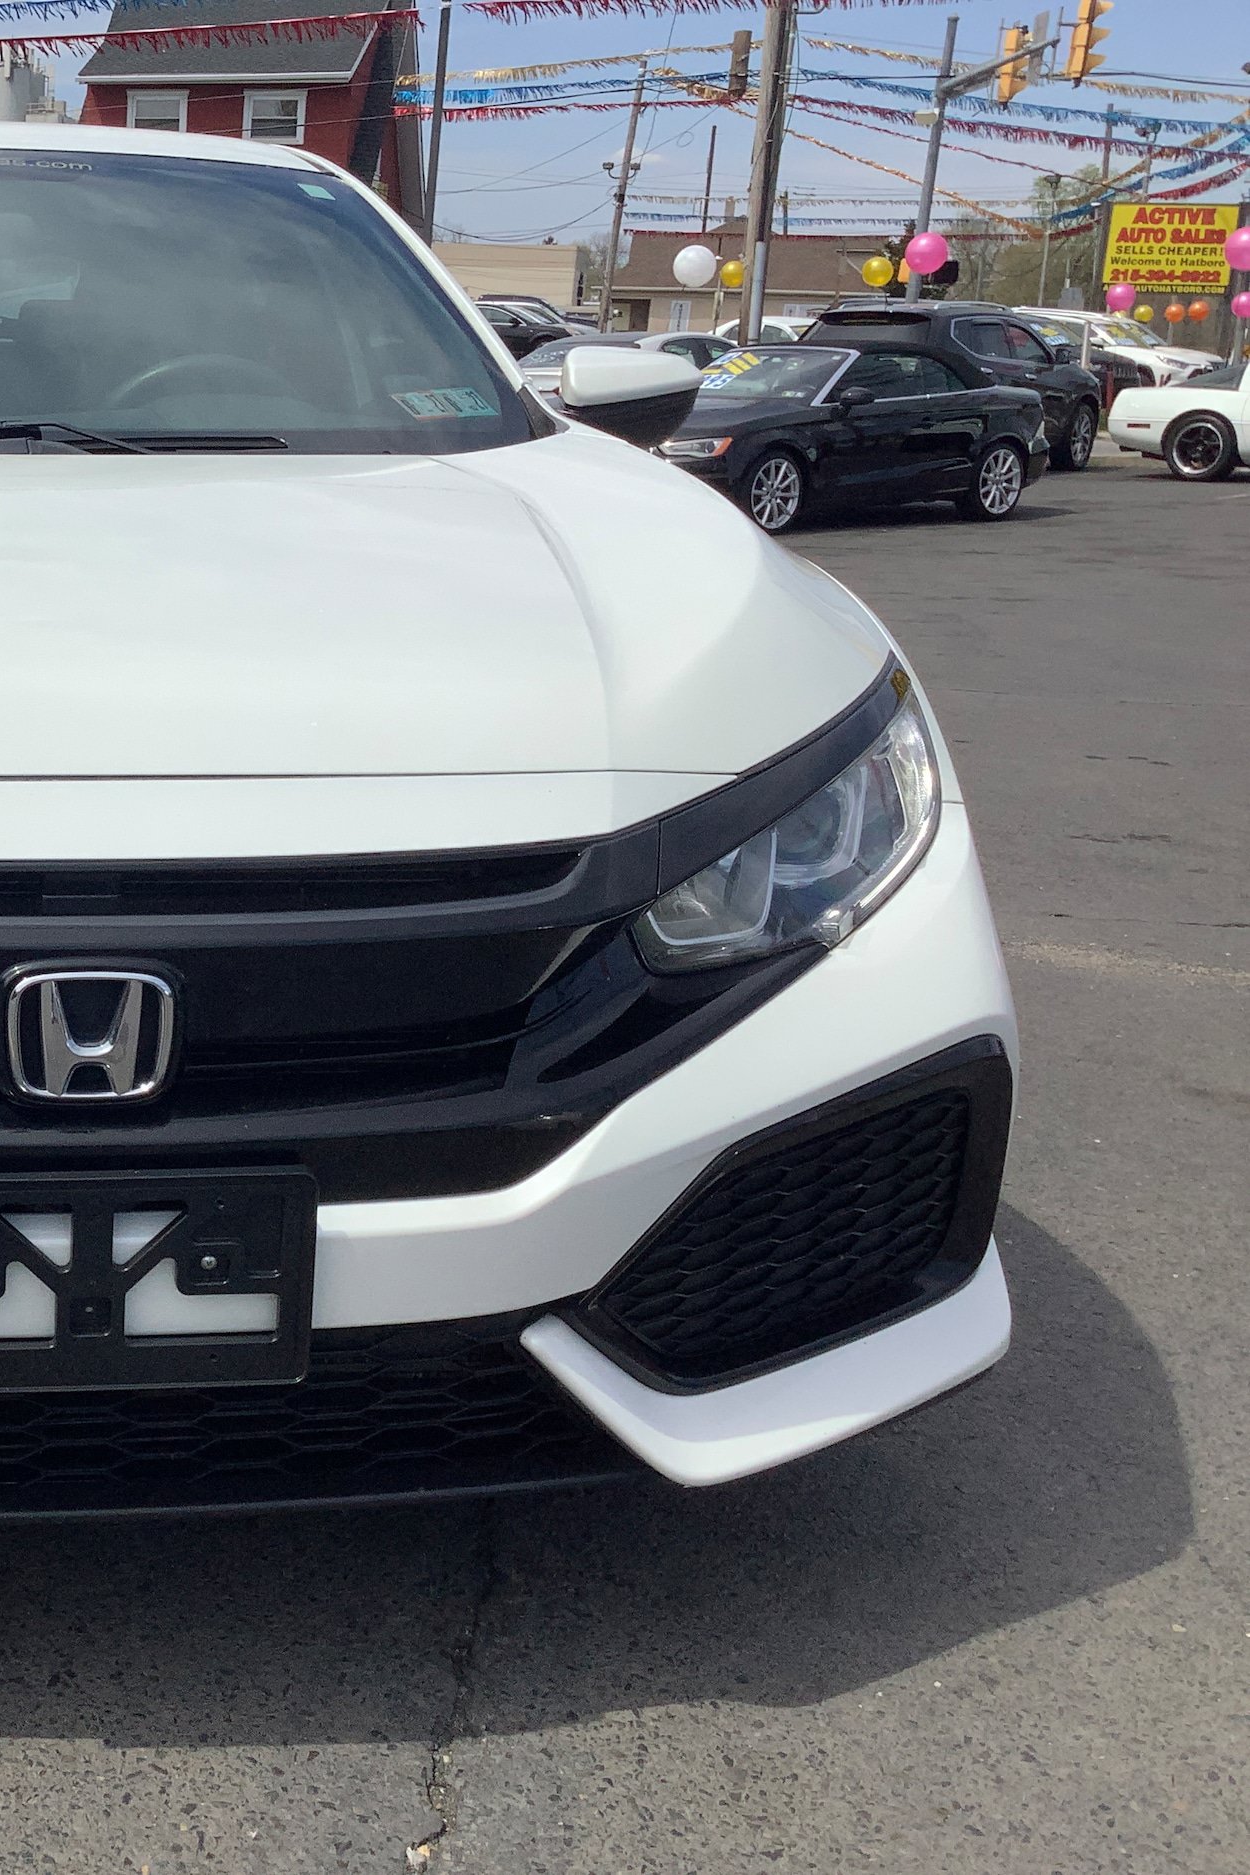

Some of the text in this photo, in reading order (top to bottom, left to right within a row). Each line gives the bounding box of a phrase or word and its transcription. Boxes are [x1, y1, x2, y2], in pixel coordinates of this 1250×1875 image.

[1132, 207, 1216, 225] ACTIVE
[1116, 227, 1227, 245] AUTO SALES
[1115, 245, 1154, 255] SELLS
[1110, 256, 1226, 267] Welcome to Hatboro
